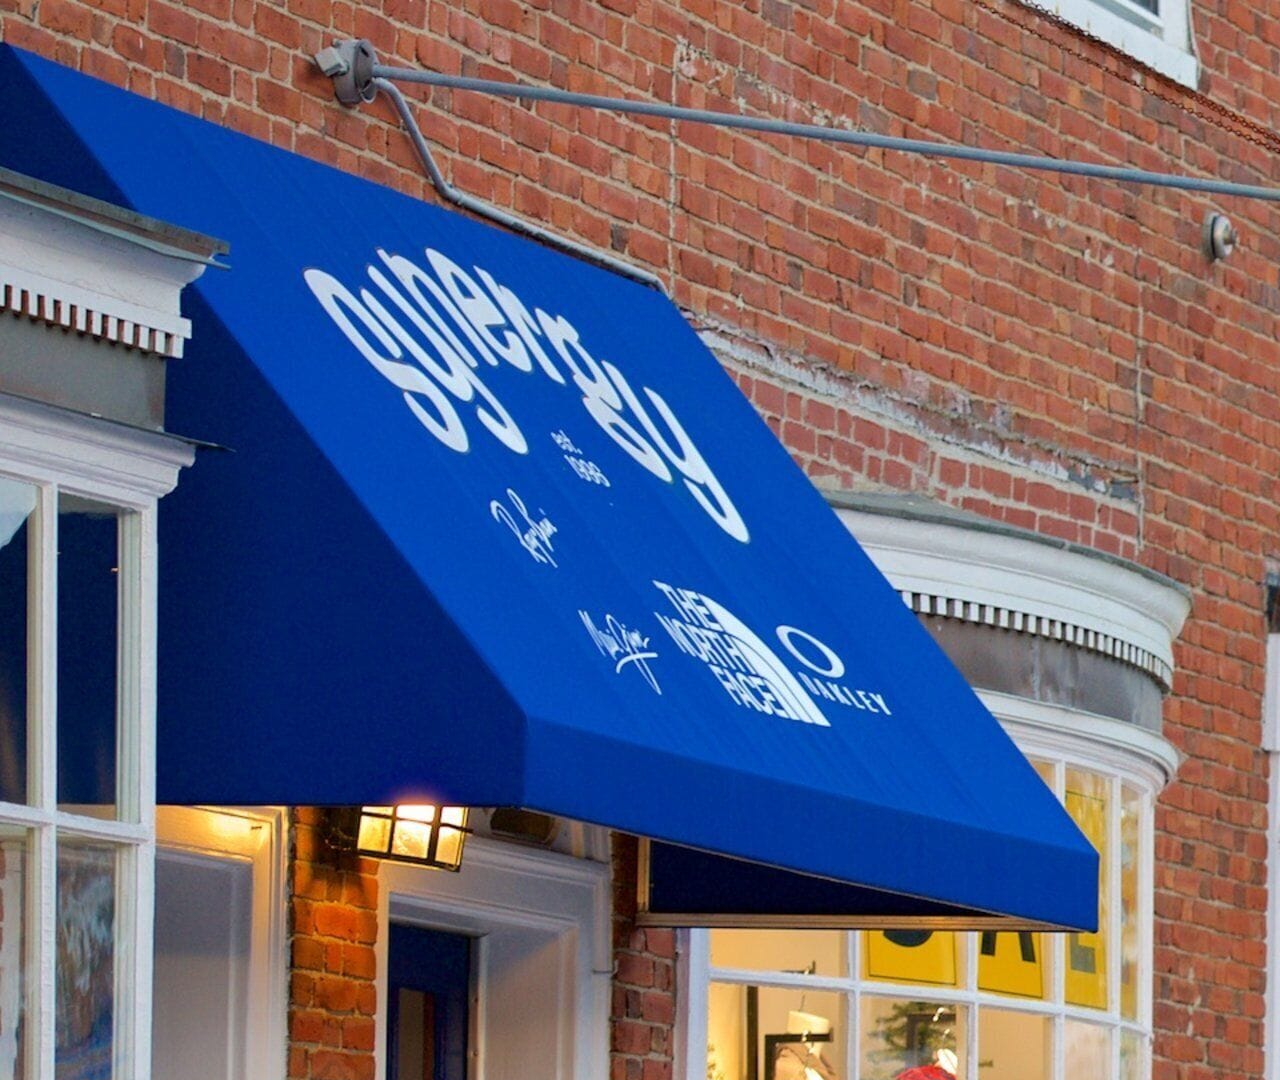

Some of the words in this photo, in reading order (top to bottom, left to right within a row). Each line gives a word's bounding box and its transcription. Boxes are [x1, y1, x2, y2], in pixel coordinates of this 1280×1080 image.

[652, 580, 725, 632] THE
[654, 611, 762, 677] NORTH
[708, 663, 789, 719] FACE
[798, 671, 893, 716] OAKLEY
